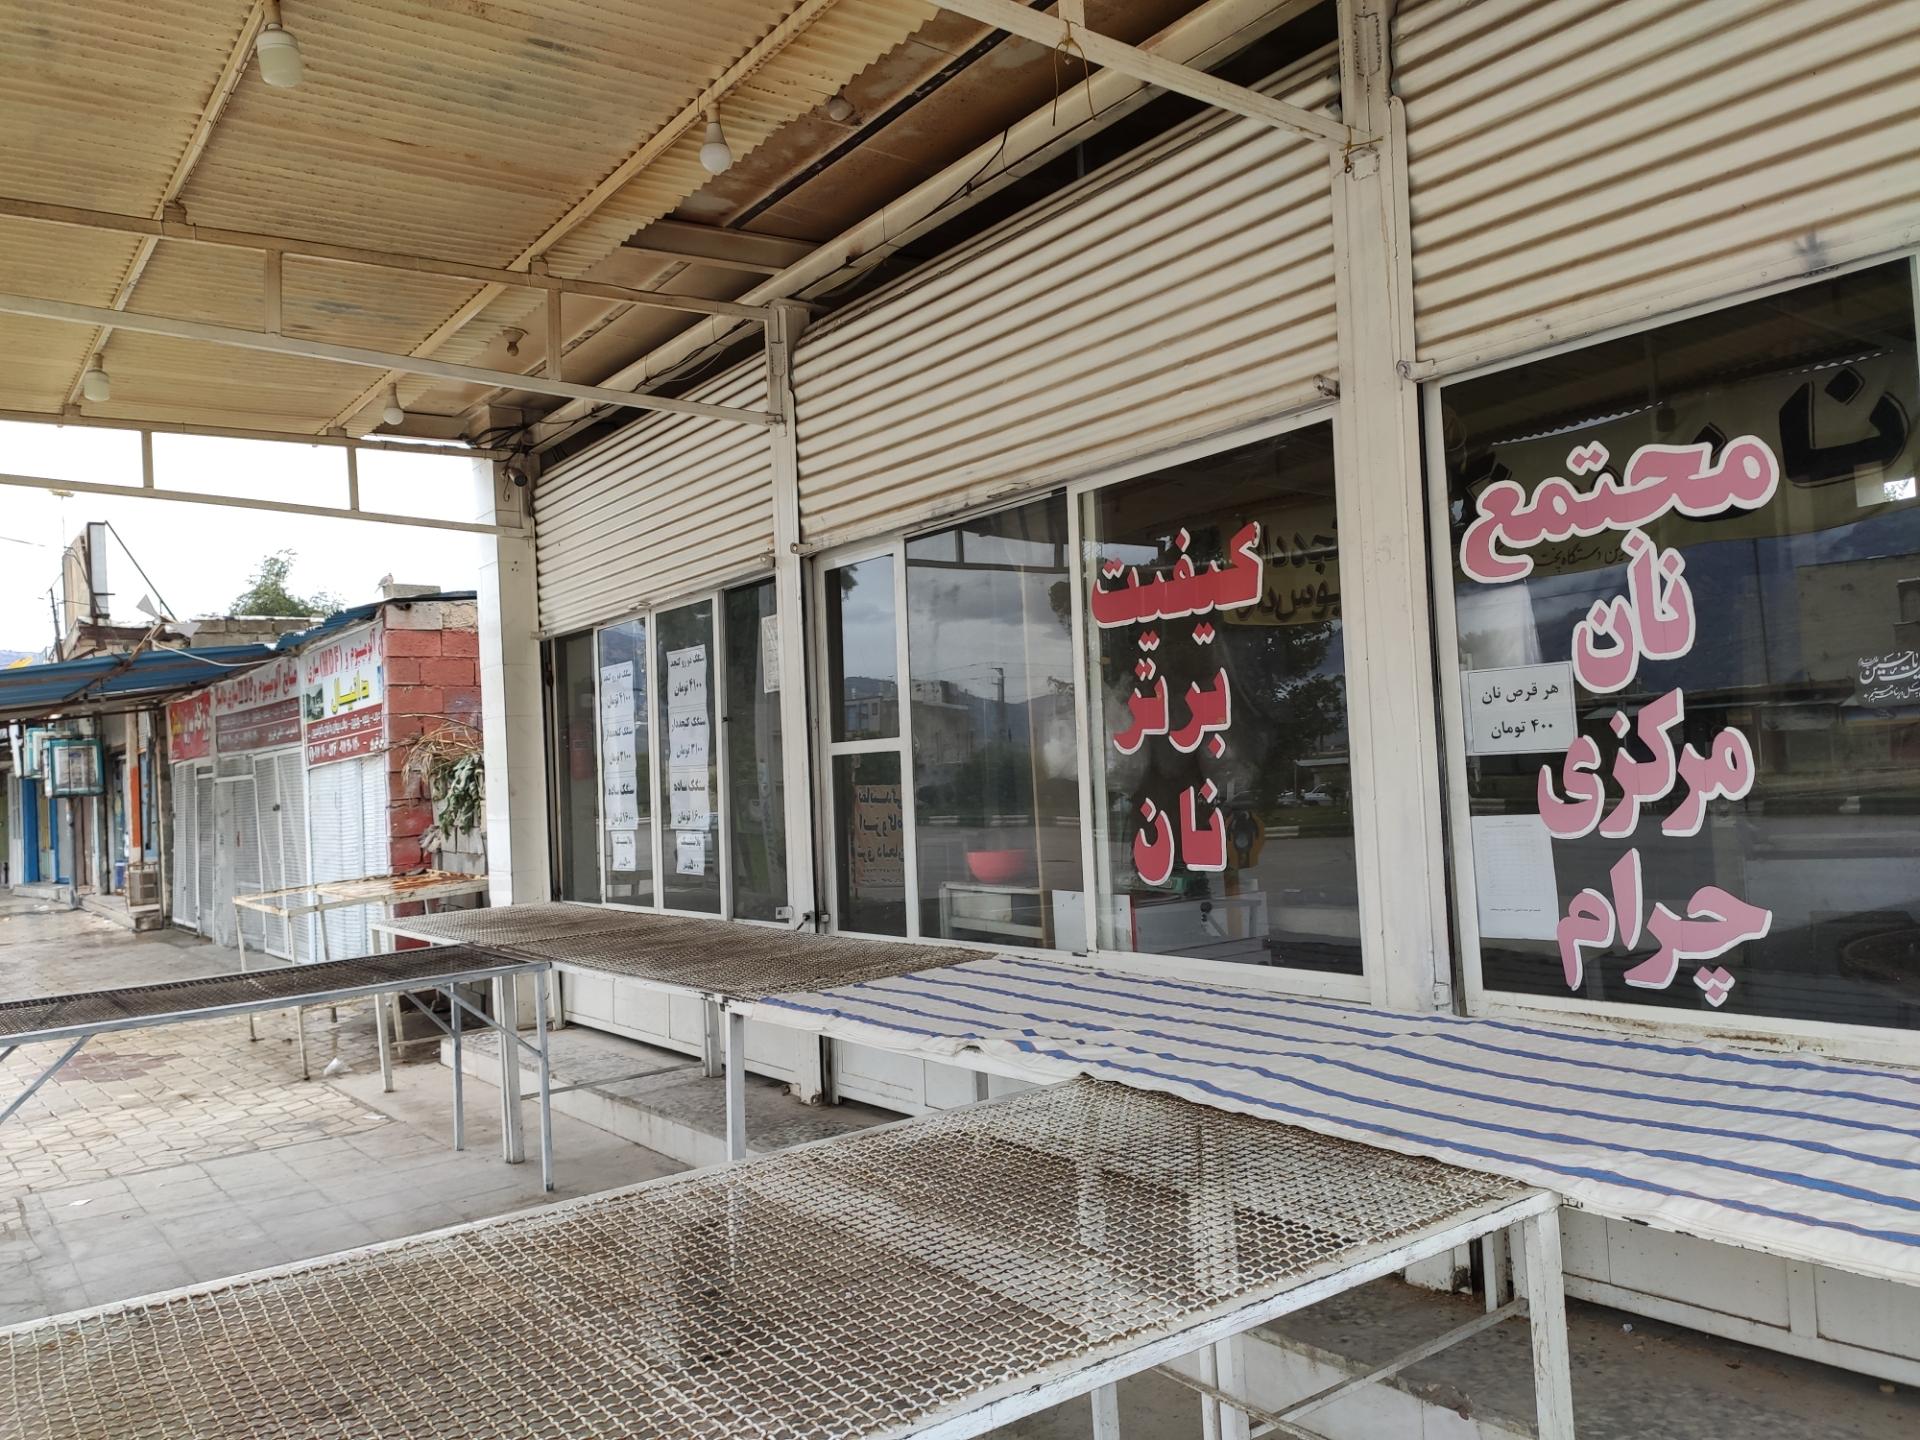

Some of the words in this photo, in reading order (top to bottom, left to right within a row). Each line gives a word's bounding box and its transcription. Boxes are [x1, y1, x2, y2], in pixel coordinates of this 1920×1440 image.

[1460, 434, 1779, 583] مجتمع
[1091, 520, 1264, 651] کیفیت
[1572, 529, 1696, 693] نان
[1113, 658, 1231, 758] برتر
[1482, 687, 1502, 705] نان
[1491, 719, 1527, 740] تومان
[1507, 683, 1539, 706] قرص
[1531, 720, 1554, 736] ۴۰۰
[1544, 684, 1560, 702] هر
[1537, 687, 1756, 840] مرکزی
[1133, 778, 1228, 886] نان
[1557, 848, 1773, 1008] چرام
